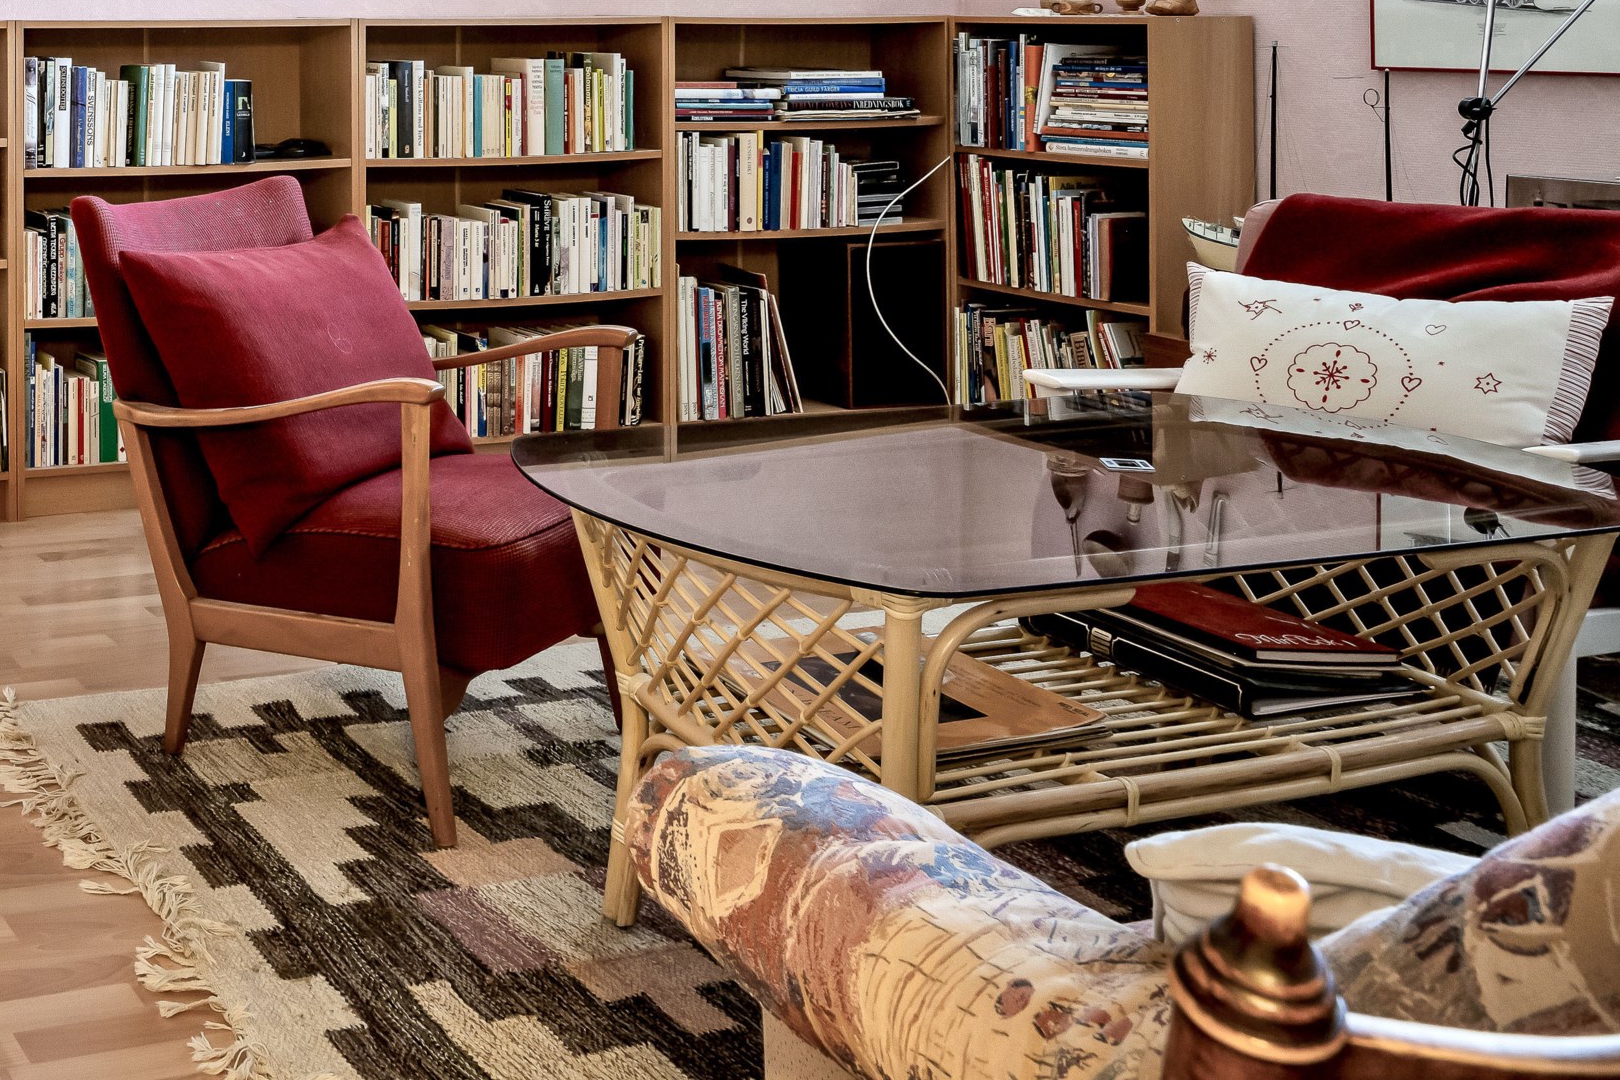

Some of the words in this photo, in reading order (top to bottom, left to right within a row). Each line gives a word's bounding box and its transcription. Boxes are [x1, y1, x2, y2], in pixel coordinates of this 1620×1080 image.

[853, 100, 905, 109] INREDNINGSBOK
[87, 95, 95, 147] SVENSSONS
[544, 200, 552, 232] SHREVE
[58, 237, 66, 259] Grupp
[715, 301, 723, 320] KINA
[719, 355, 725, 365] OM
[741, 315, 749, 335] Viking
